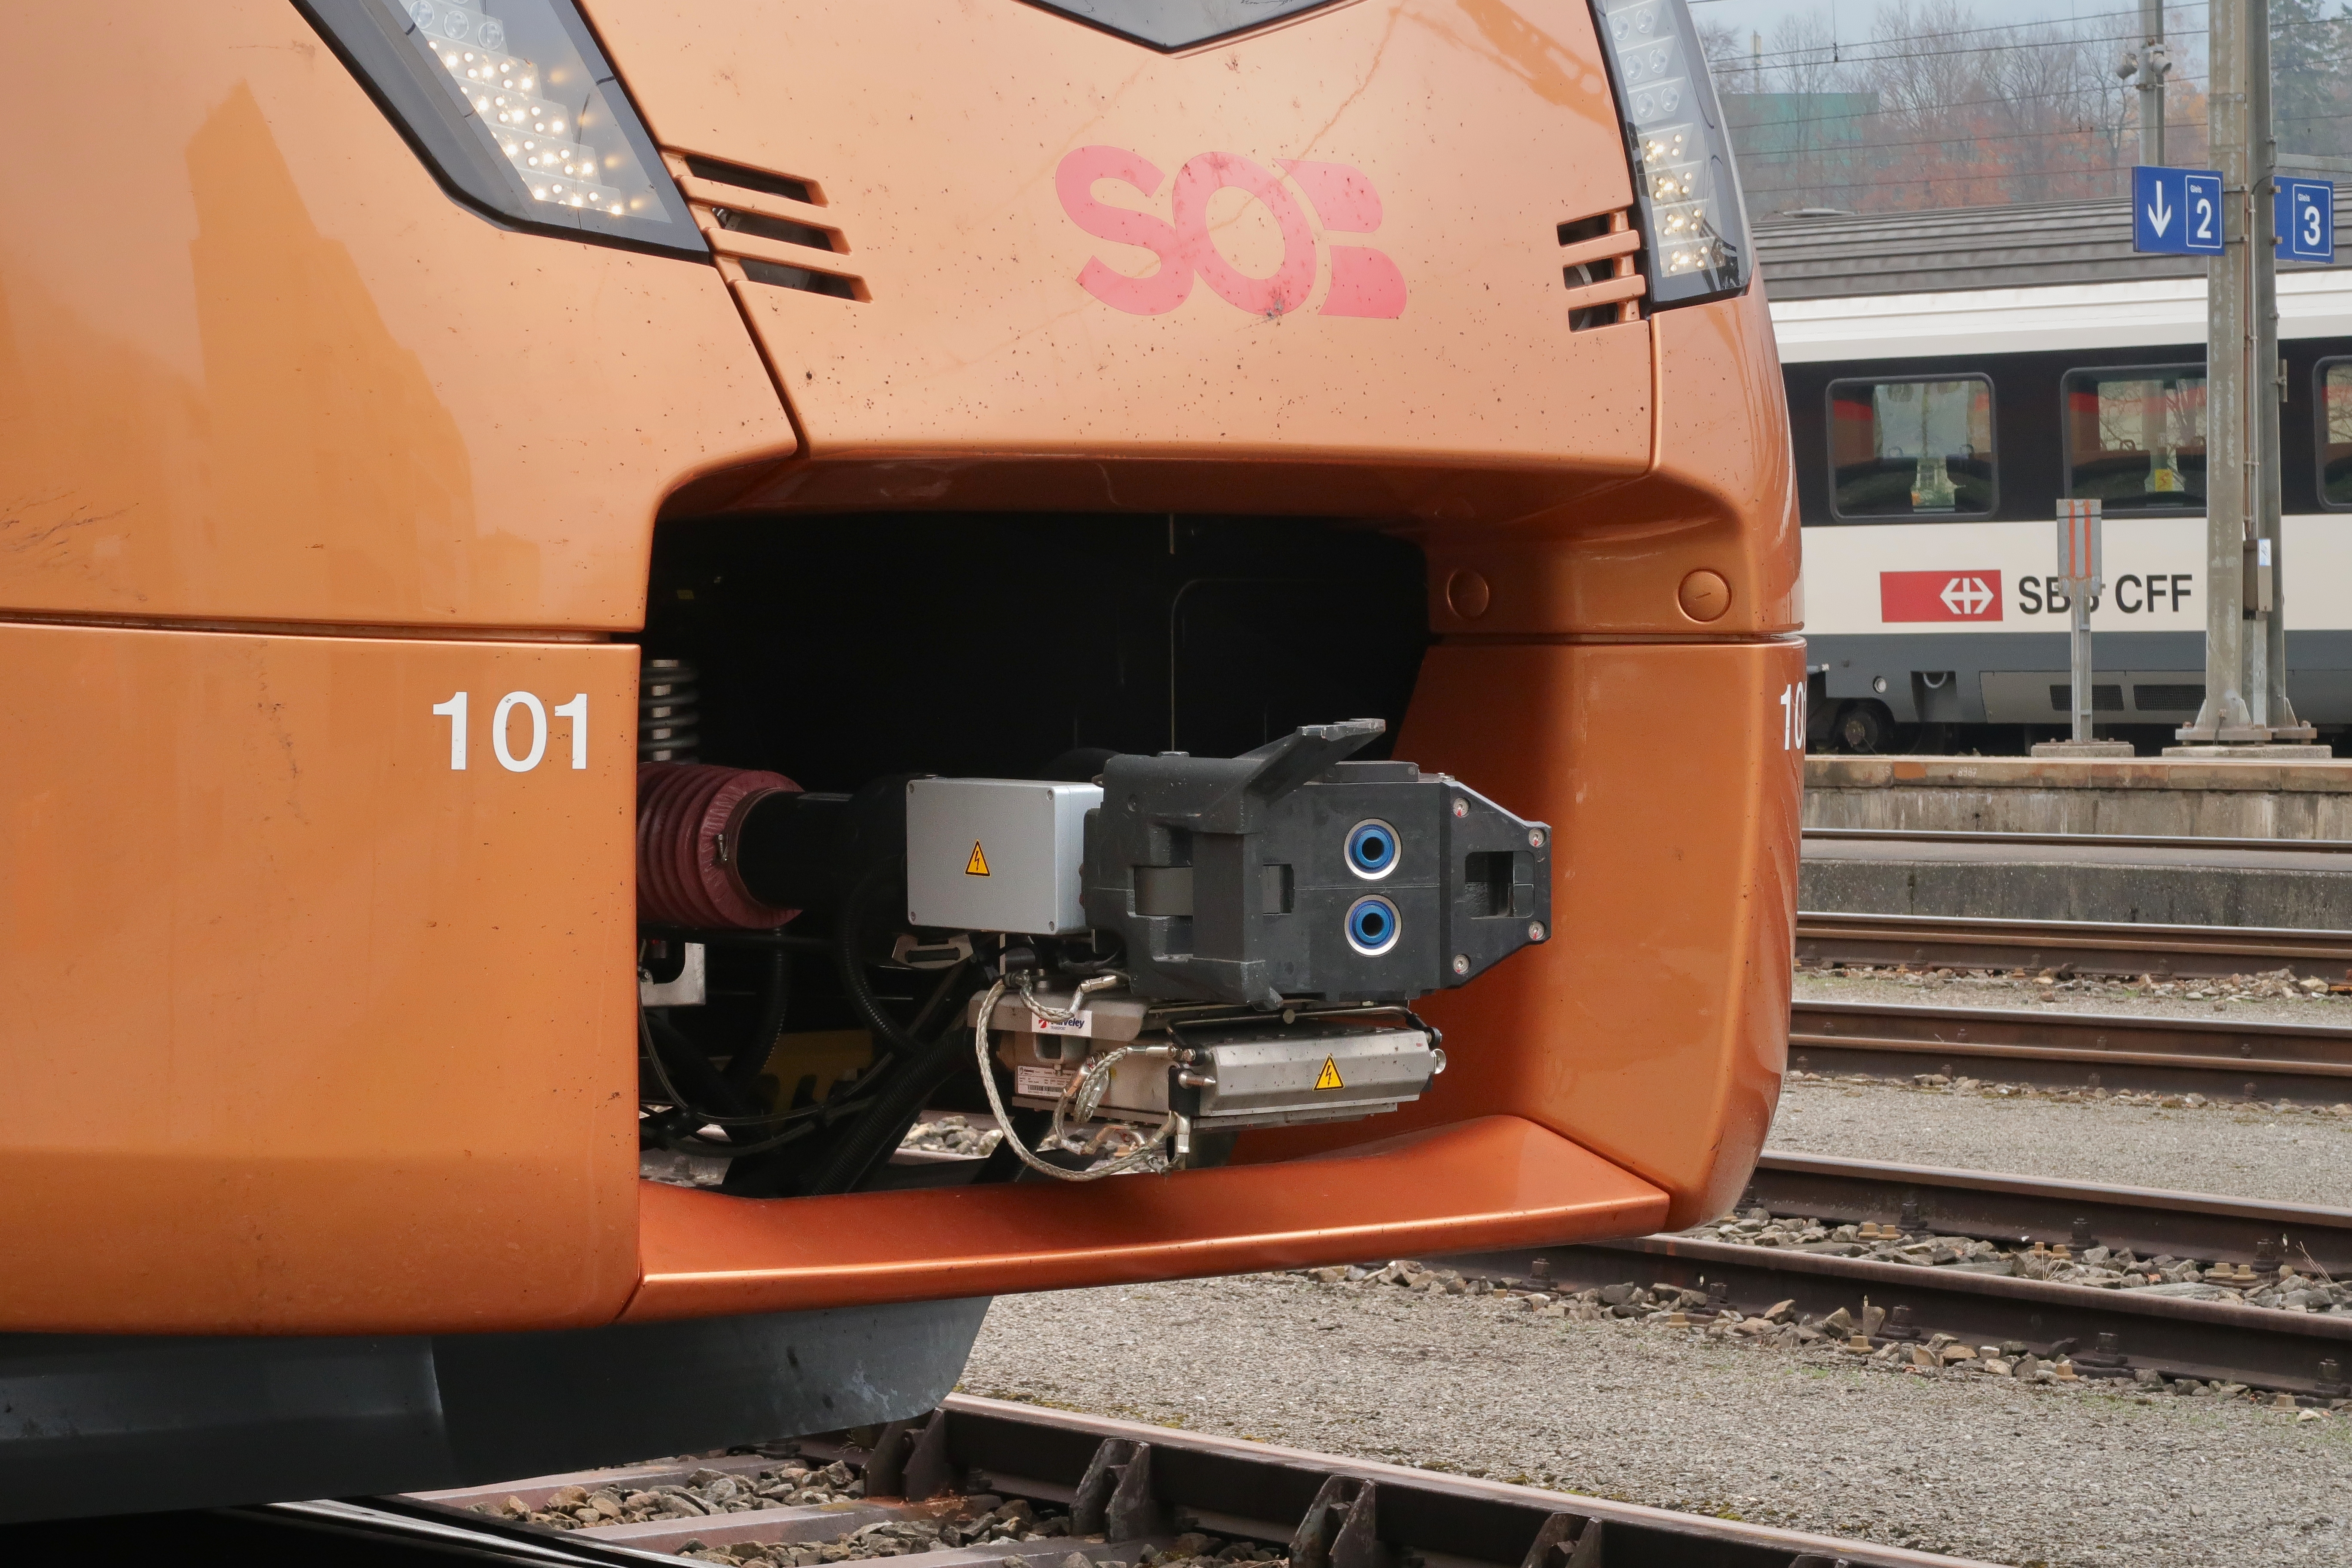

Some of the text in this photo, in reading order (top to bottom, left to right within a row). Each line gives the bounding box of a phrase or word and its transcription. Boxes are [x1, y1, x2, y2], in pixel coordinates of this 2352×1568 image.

[2297, 193, 2311, 202] Gleis
[2196, 198, 2212, 239] 2
[2303, 206, 2321, 246] 3
[2115, 574, 2193, 614] CFF
[432, 690, 588, 773] 101
[1051, 1017, 1085, 1029] veley
